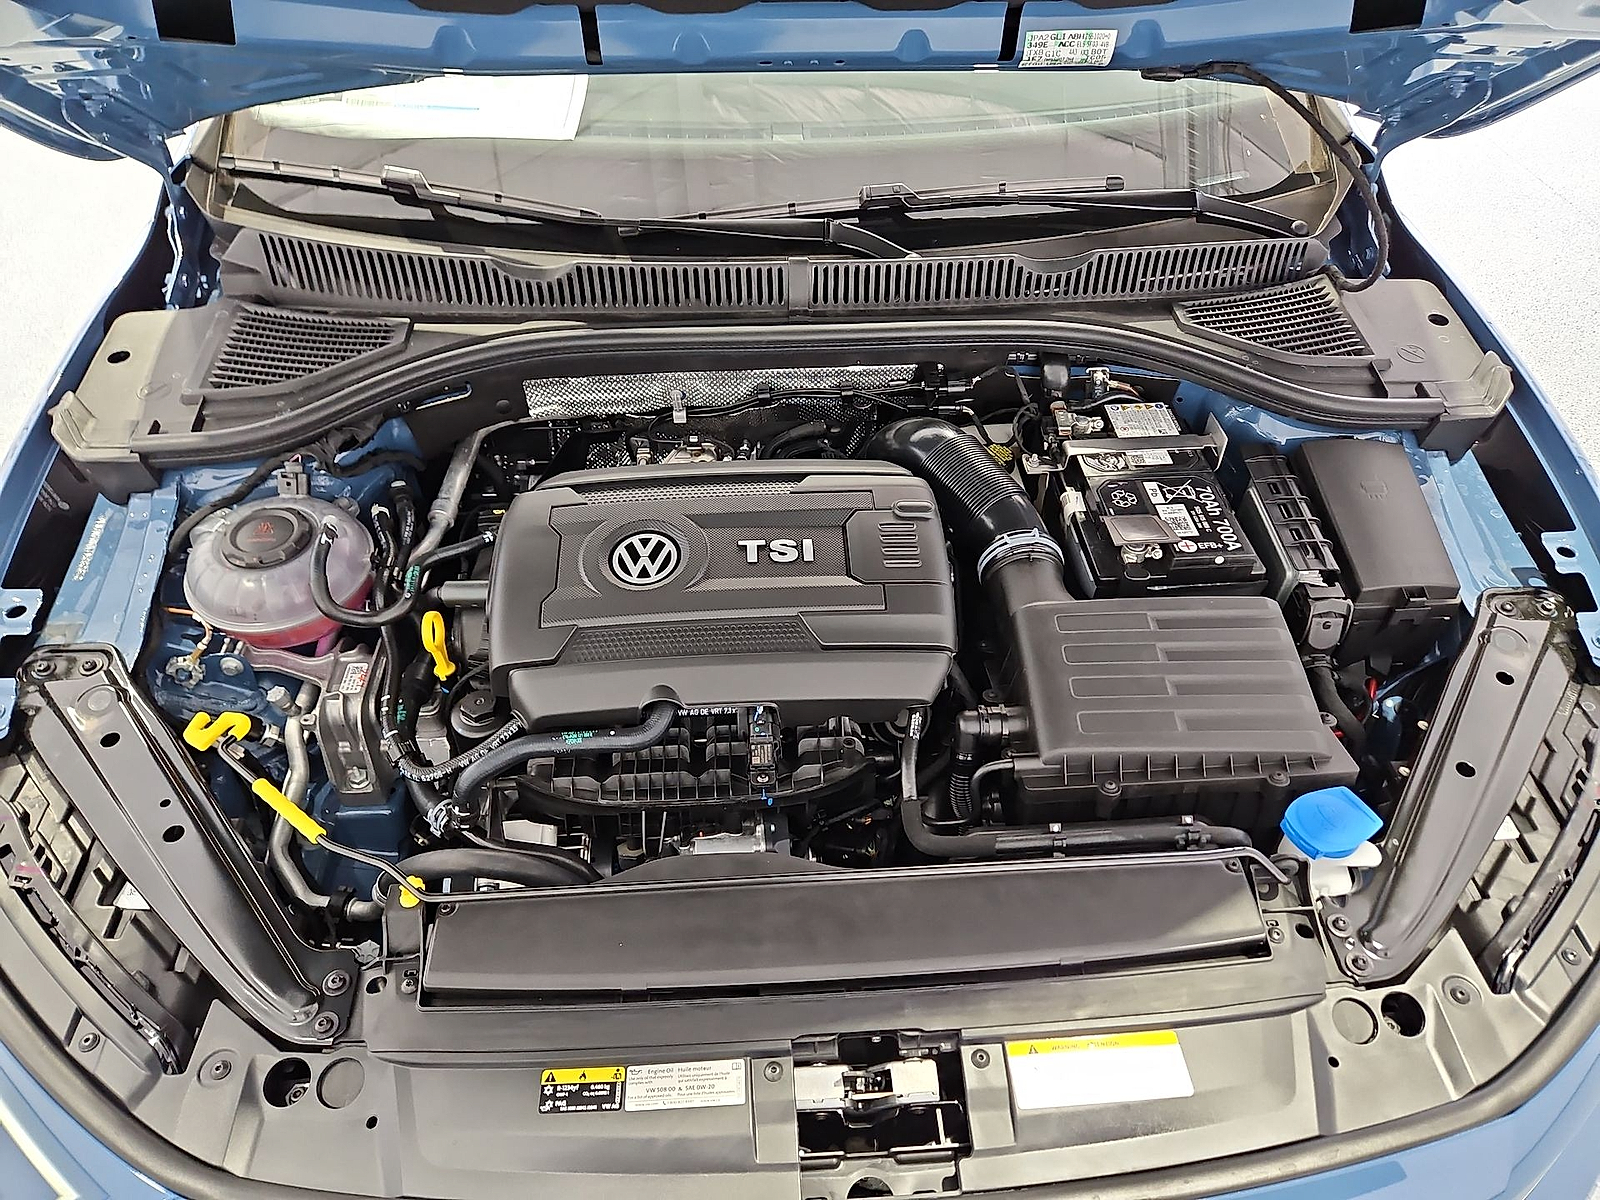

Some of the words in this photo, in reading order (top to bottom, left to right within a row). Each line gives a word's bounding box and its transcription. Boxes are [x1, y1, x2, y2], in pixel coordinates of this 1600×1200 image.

[1149, 488, 1158, 498] Pb
[1195, 486, 1223, 516] 70Ah
[1212, 518, 1242, 552] 700A
[612, 533, 678, 584] VW
[737, 538, 815, 563] TSI
[647, 1068, 666, 1076] Engine
